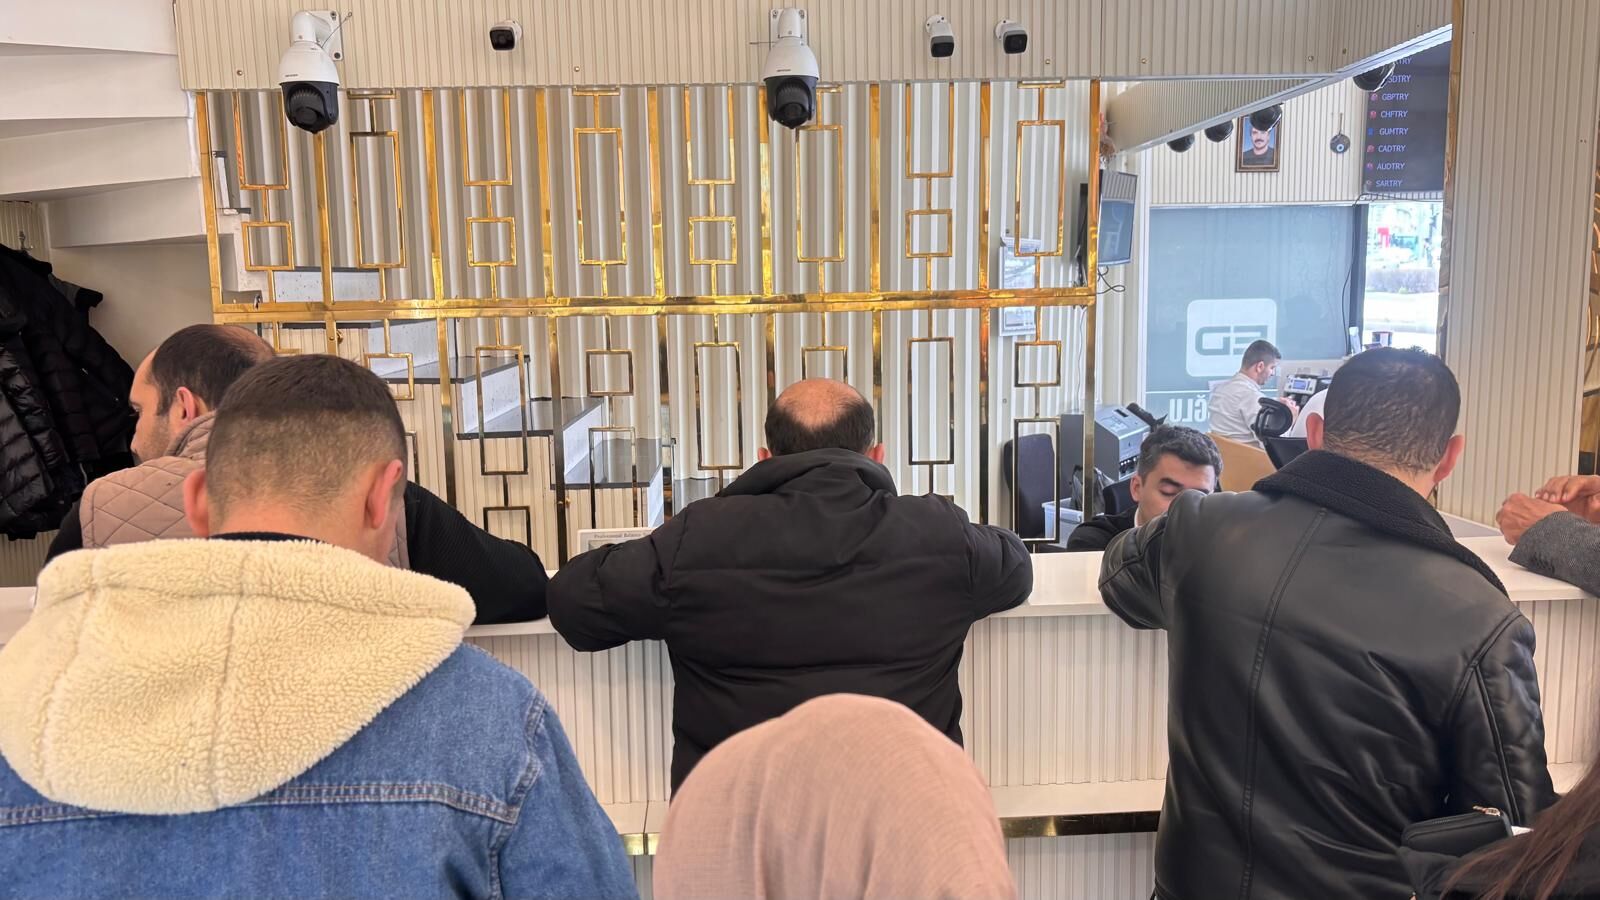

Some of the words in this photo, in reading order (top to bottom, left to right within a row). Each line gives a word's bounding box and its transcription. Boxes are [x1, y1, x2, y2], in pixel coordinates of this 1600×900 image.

[1382, 93, 1409, 101] GBPTRY
[1380, 110, 1408, 118] CHFTRY
[1379, 127, 1409, 135] GUMTRY
[1378, 144, 1406, 152] CADTRY
[1377, 162, 1405, 170] AUDTRY
[1376, 179, 1402, 187] SARTRY
